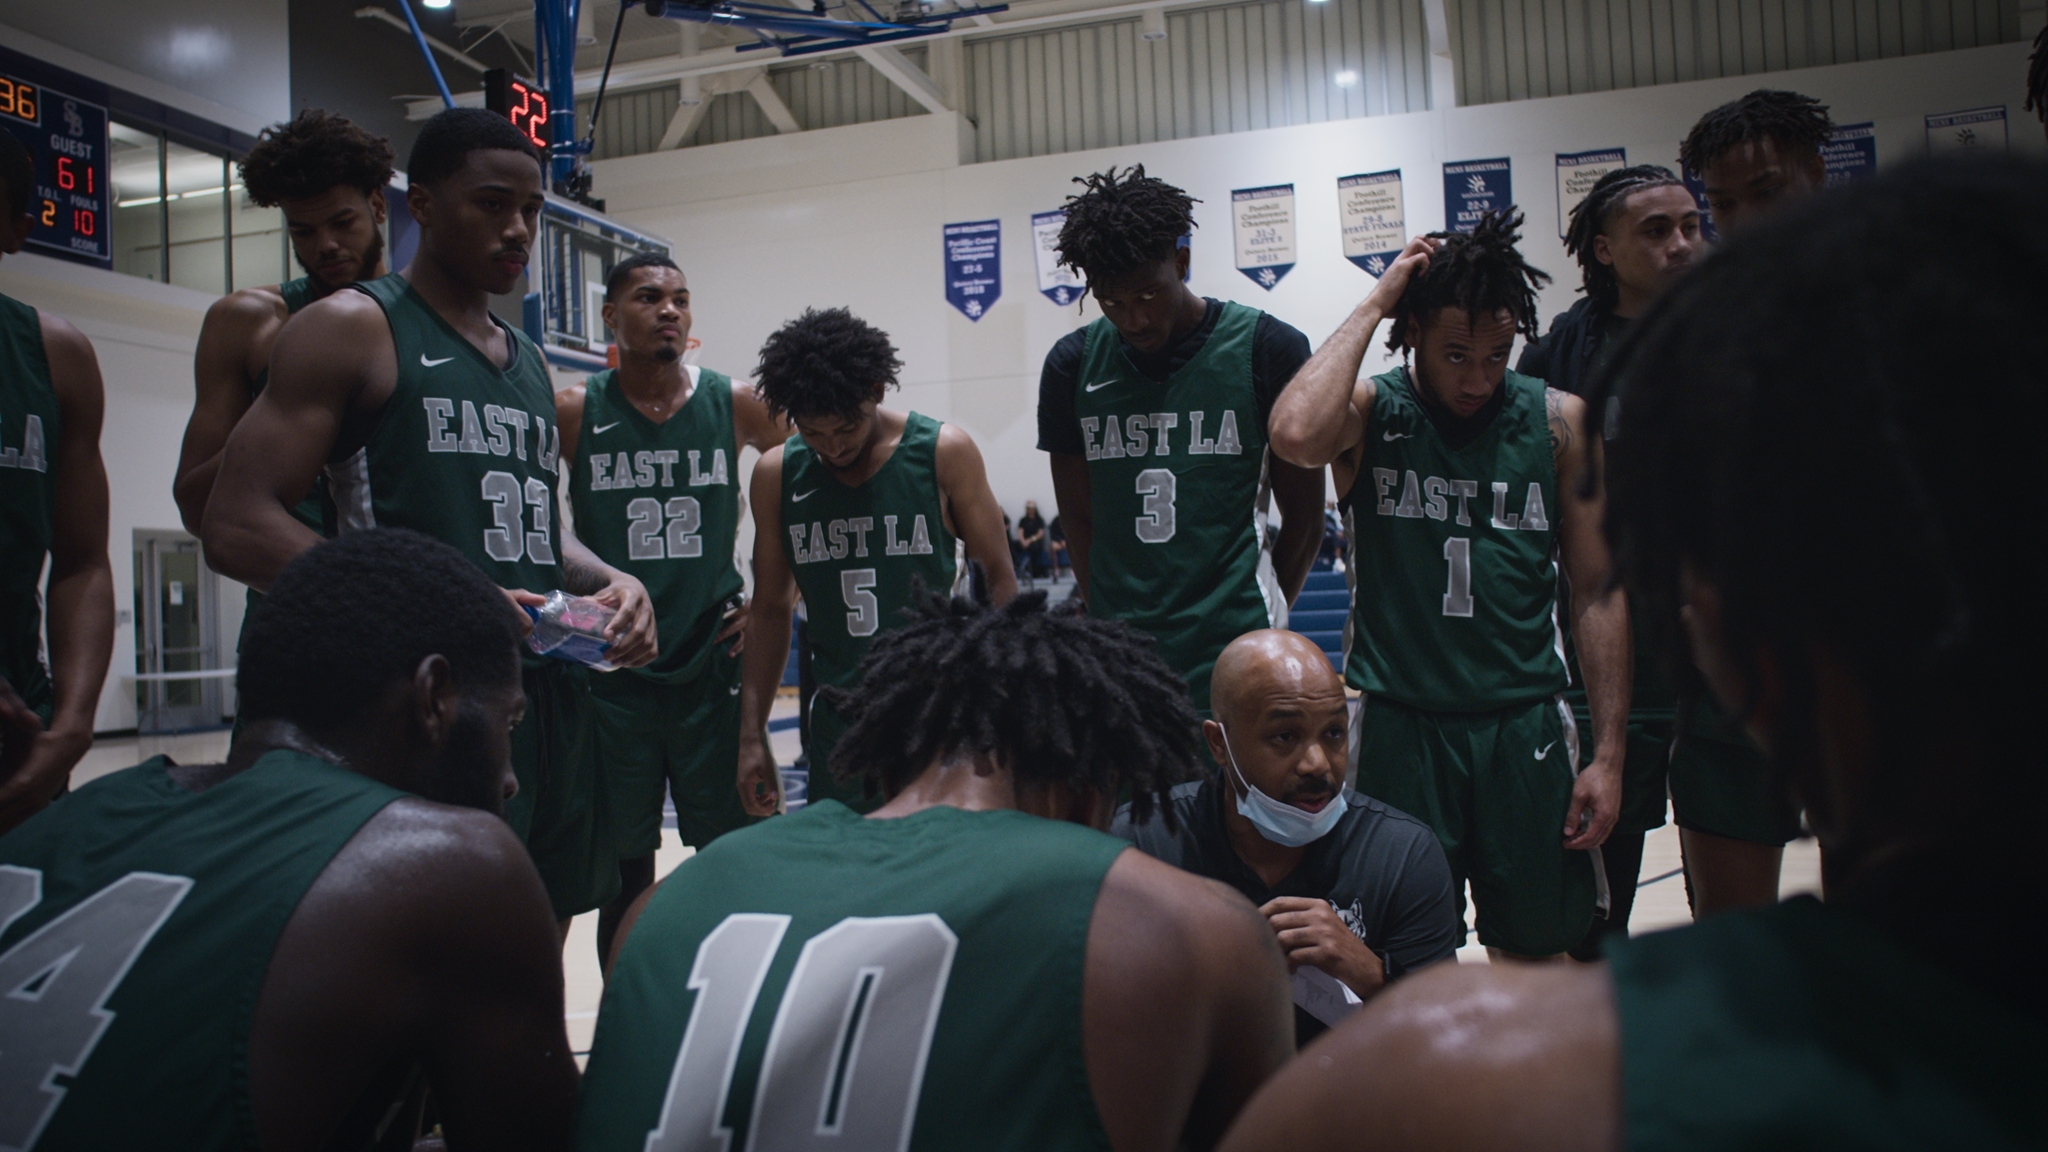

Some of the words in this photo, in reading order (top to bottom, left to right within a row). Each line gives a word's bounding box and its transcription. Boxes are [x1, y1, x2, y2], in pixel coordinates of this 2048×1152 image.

[0, 77, 36, 120] 36
[63, 100, 84, 138] SB
[510, 82, 548, 147] 22
[50, 133, 93, 160] GUEST
[1577, 152, 1623, 164] BASKETBALL
[57, 156, 94, 194] 61
[1445, 165, 1464, 174] MENS
[1464, 162, 1508, 173] BASKETBALL
[1574, 168, 1608, 178] Foothill
[70, 193, 99, 212] FOULS
[1347, 197, 1396, 208] Conference
[1354, 189, 1387, 199] Foothill
[41, 199, 56, 227] 2
[1241, 211, 1288, 221] Conference
[1248, 203, 1280, 213] Foothill
[1348, 205, 1396, 216] Champions
[1457, 210, 1484, 222] ELIT
[73, 209, 95, 236] 10
[1242, 218, 1289, 229] Champions
[1343, 225, 1369, 235] STATE
[1372, 220, 1405, 231] FINALS
[70, 235, 99, 252] SCORE
[951, 252, 995, 262] Champions
[1364, 240, 1387, 251] 2014
[422, 397, 530, 462] EAST
[1080, 413, 1178, 462] EAST
[1188, 409, 1243, 456] LA
[589, 450, 680, 491] EAST
[687, 448, 729, 487] LA
[1135, 468, 1177, 544] 3
[1372, 467, 1478, 528] EAST
[1490, 481, 1549, 531] LA
[480, 470, 556, 566] 33
[626, 495, 703, 561] 22
[789, 516, 874, 565] EAST
[884, 514, 934, 557] LA
[1442, 536, 1474, 618] 1
[840, 568, 879, 637] 5
[642, 912, 960, 1152] 10
